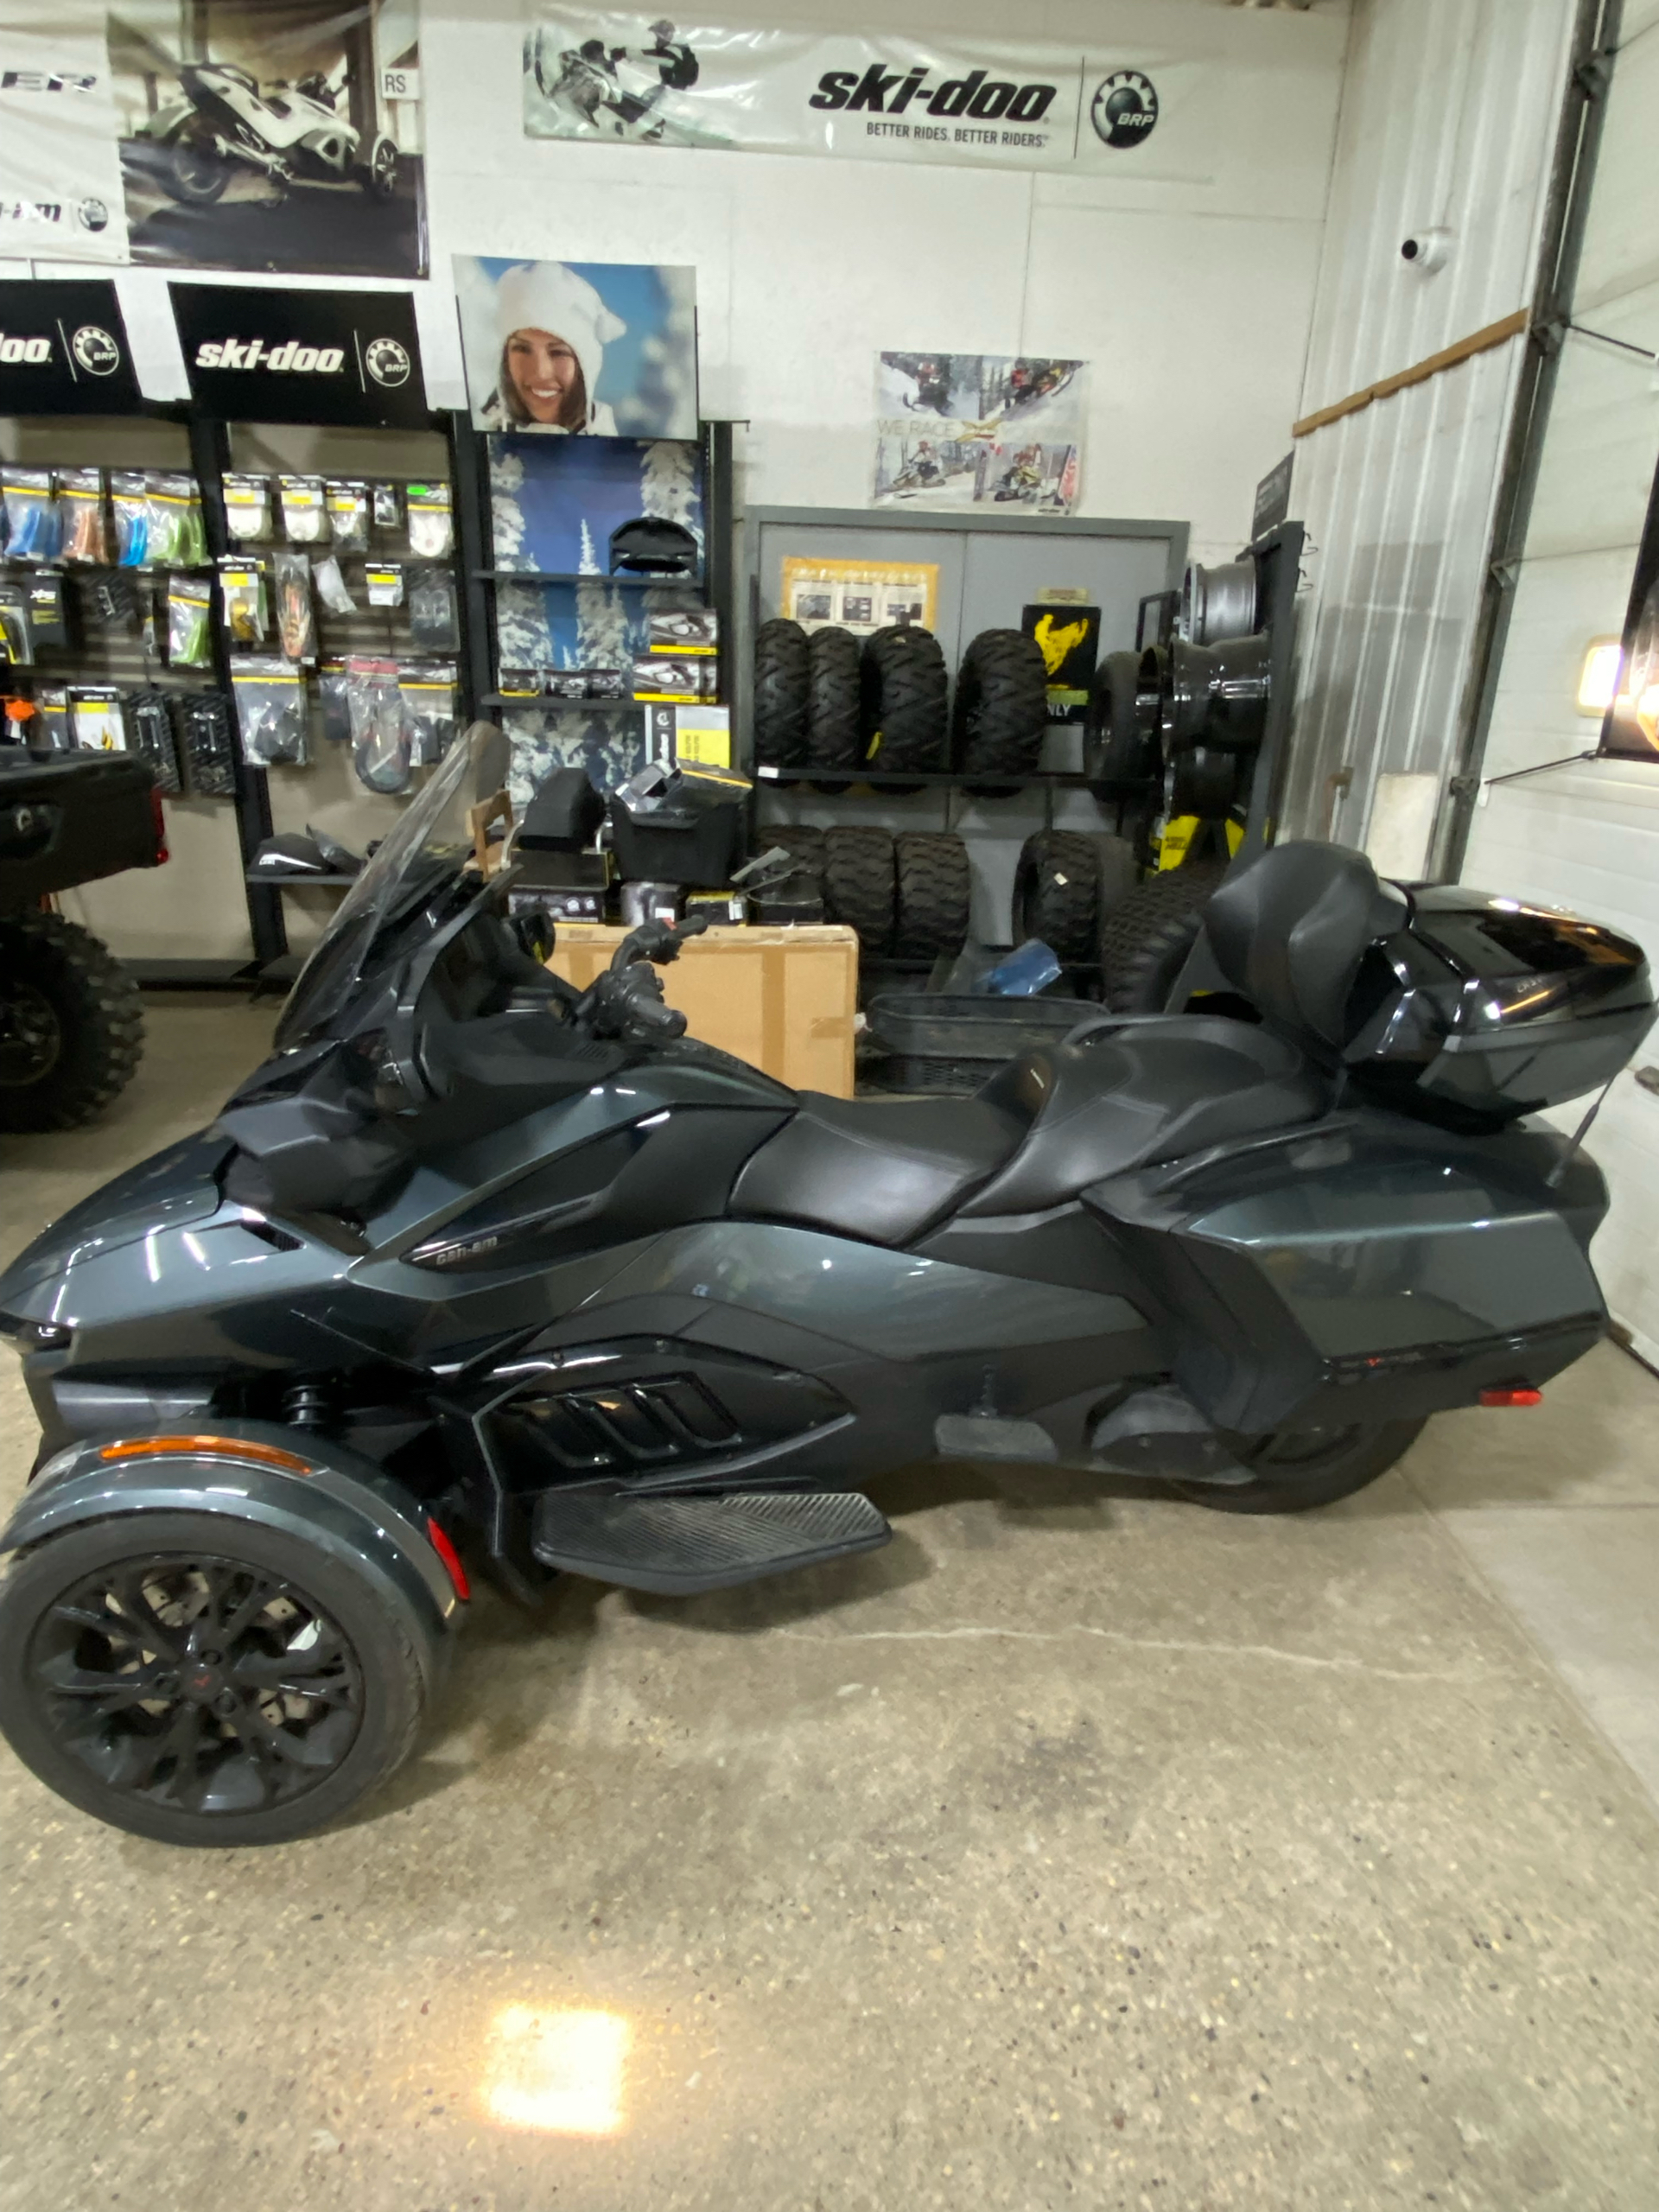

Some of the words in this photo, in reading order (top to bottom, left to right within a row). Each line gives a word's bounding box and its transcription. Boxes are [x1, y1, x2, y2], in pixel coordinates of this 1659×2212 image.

[385, 74, 406, 93] RS
[808, 64, 1057, 122] ski-doo
[1117, 112, 1154, 127] BRP
[867, 122, 910, 138] BETTER
[955, 129, 997, 144] BETTER
[195, 339, 344, 372] ski-doo
[1046, 703, 1071, 717] NLY
